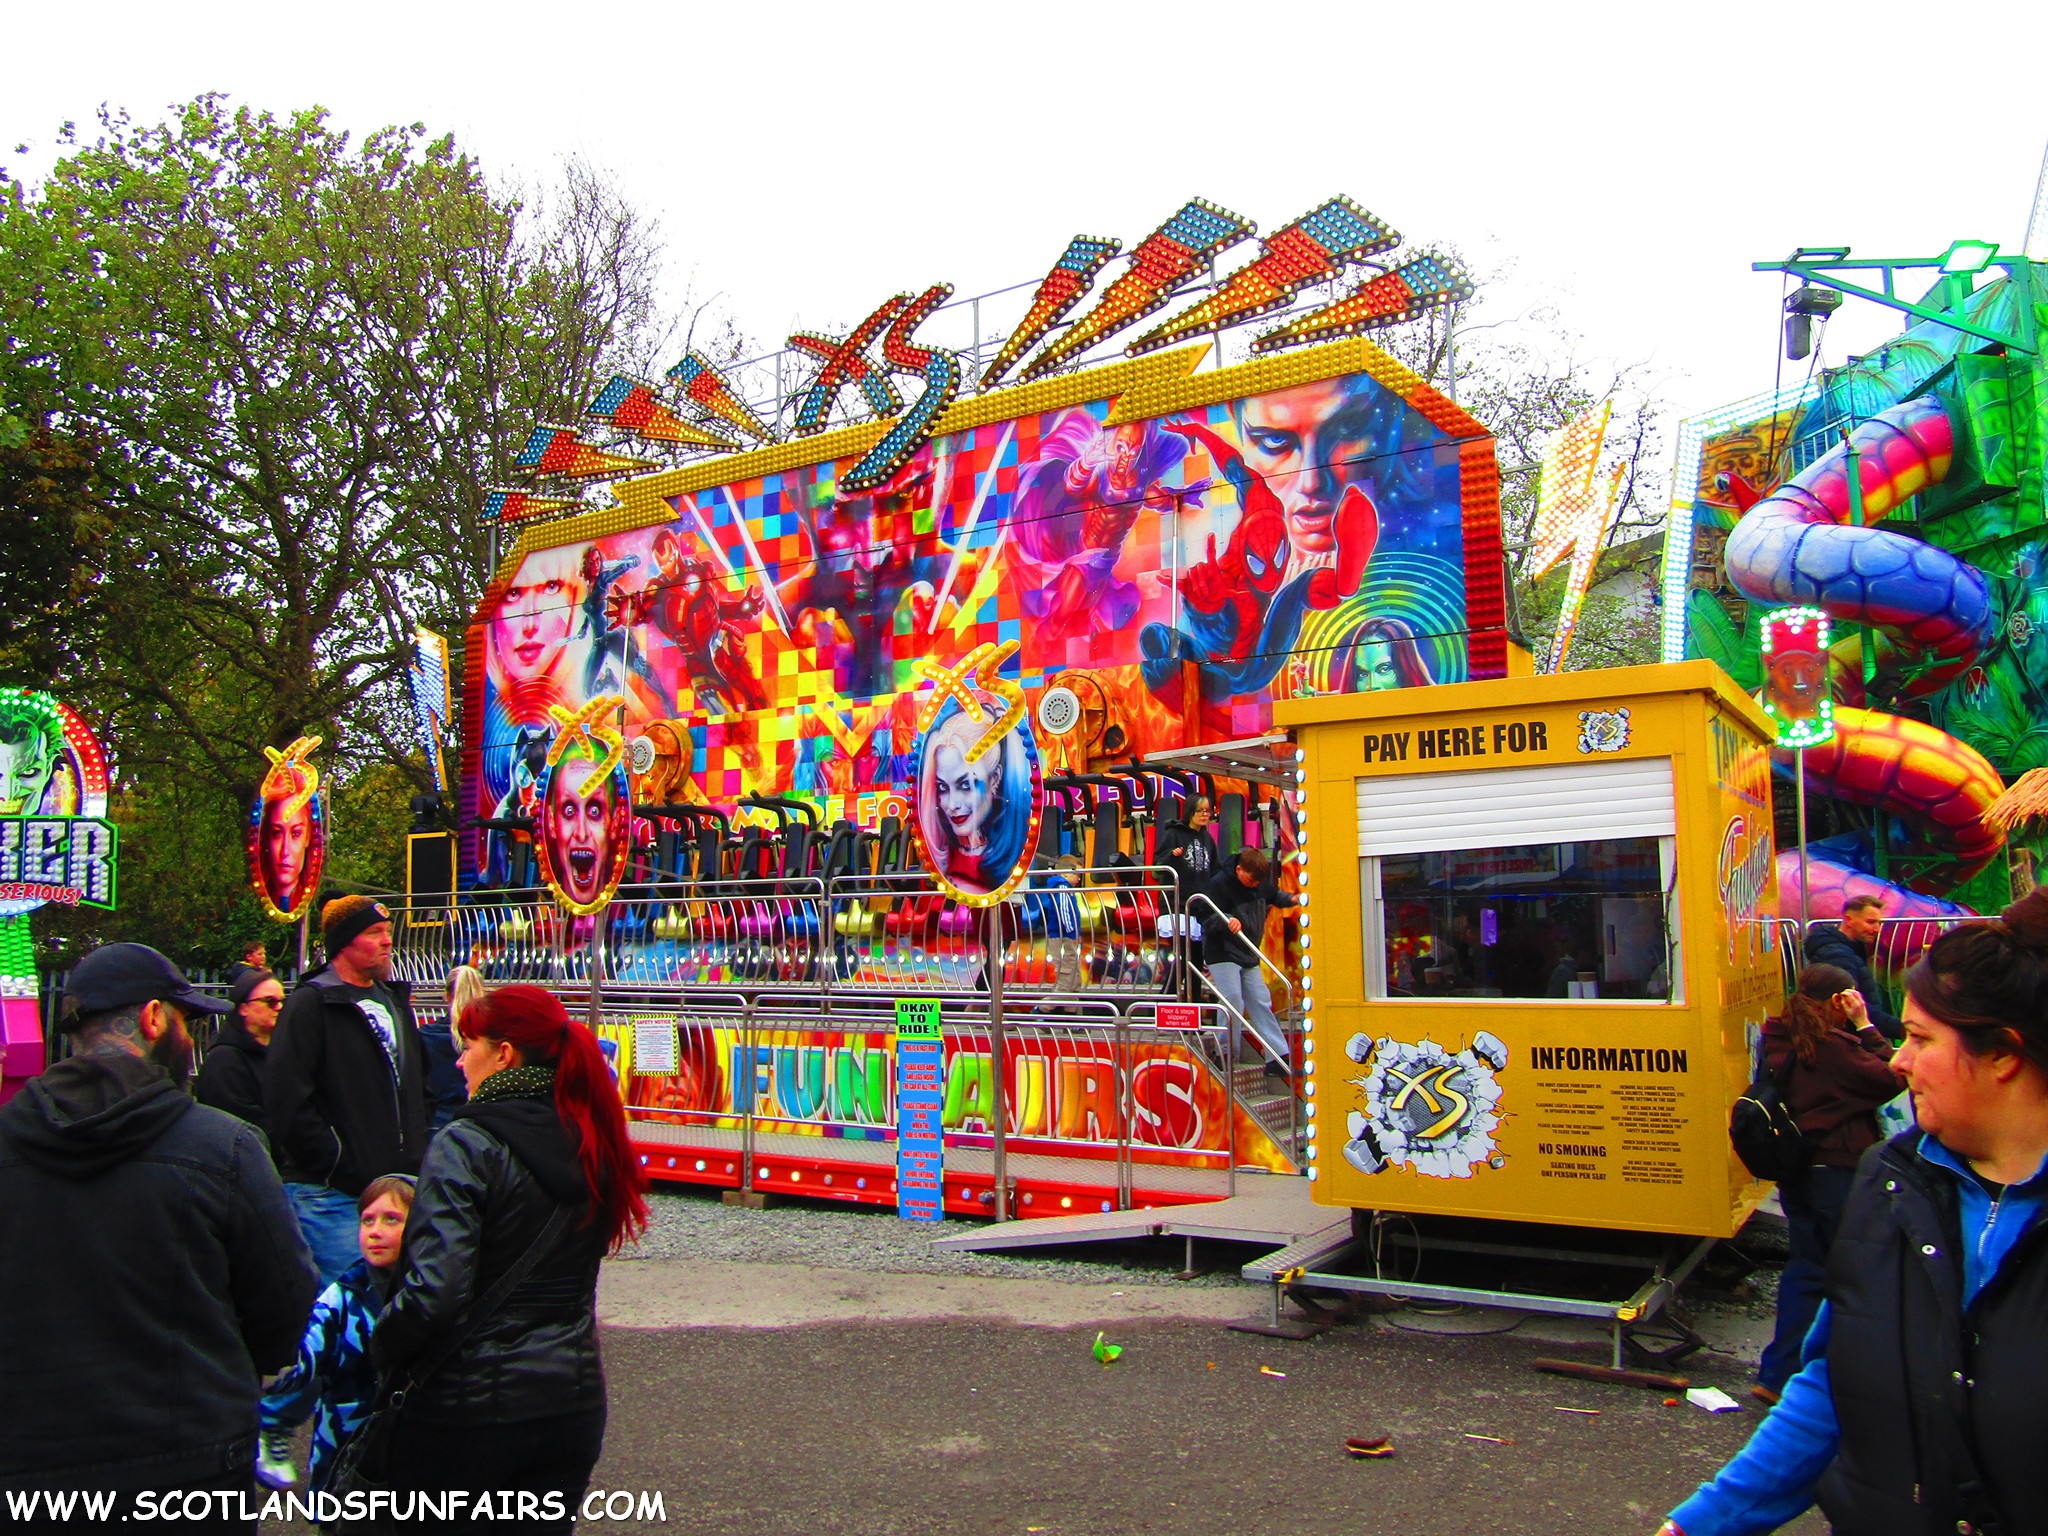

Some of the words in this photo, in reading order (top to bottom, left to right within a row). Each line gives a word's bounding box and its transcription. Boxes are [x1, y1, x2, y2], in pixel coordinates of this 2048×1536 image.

[1363, 731, 1410, 763] PAY
[1418, 725, 1488, 759] HERE
[1493, 721, 1548, 755] FOR
[0, 882, 82, 907] SERIOUS!
[900, 1003, 934, 1013] OKAY
[909, 1014, 926, 1023] TO
[899, 1024, 930, 1034] RIDE
[1531, 1047, 1688, 1073] INFORMATION
[732, 1044, 1203, 1148] FUNAIRS
[1386, 1064, 1470, 1139] XS
[1539, 1143, 1552, 1154] NO
[1556, 1144, 1606, 1157] SMOKING
